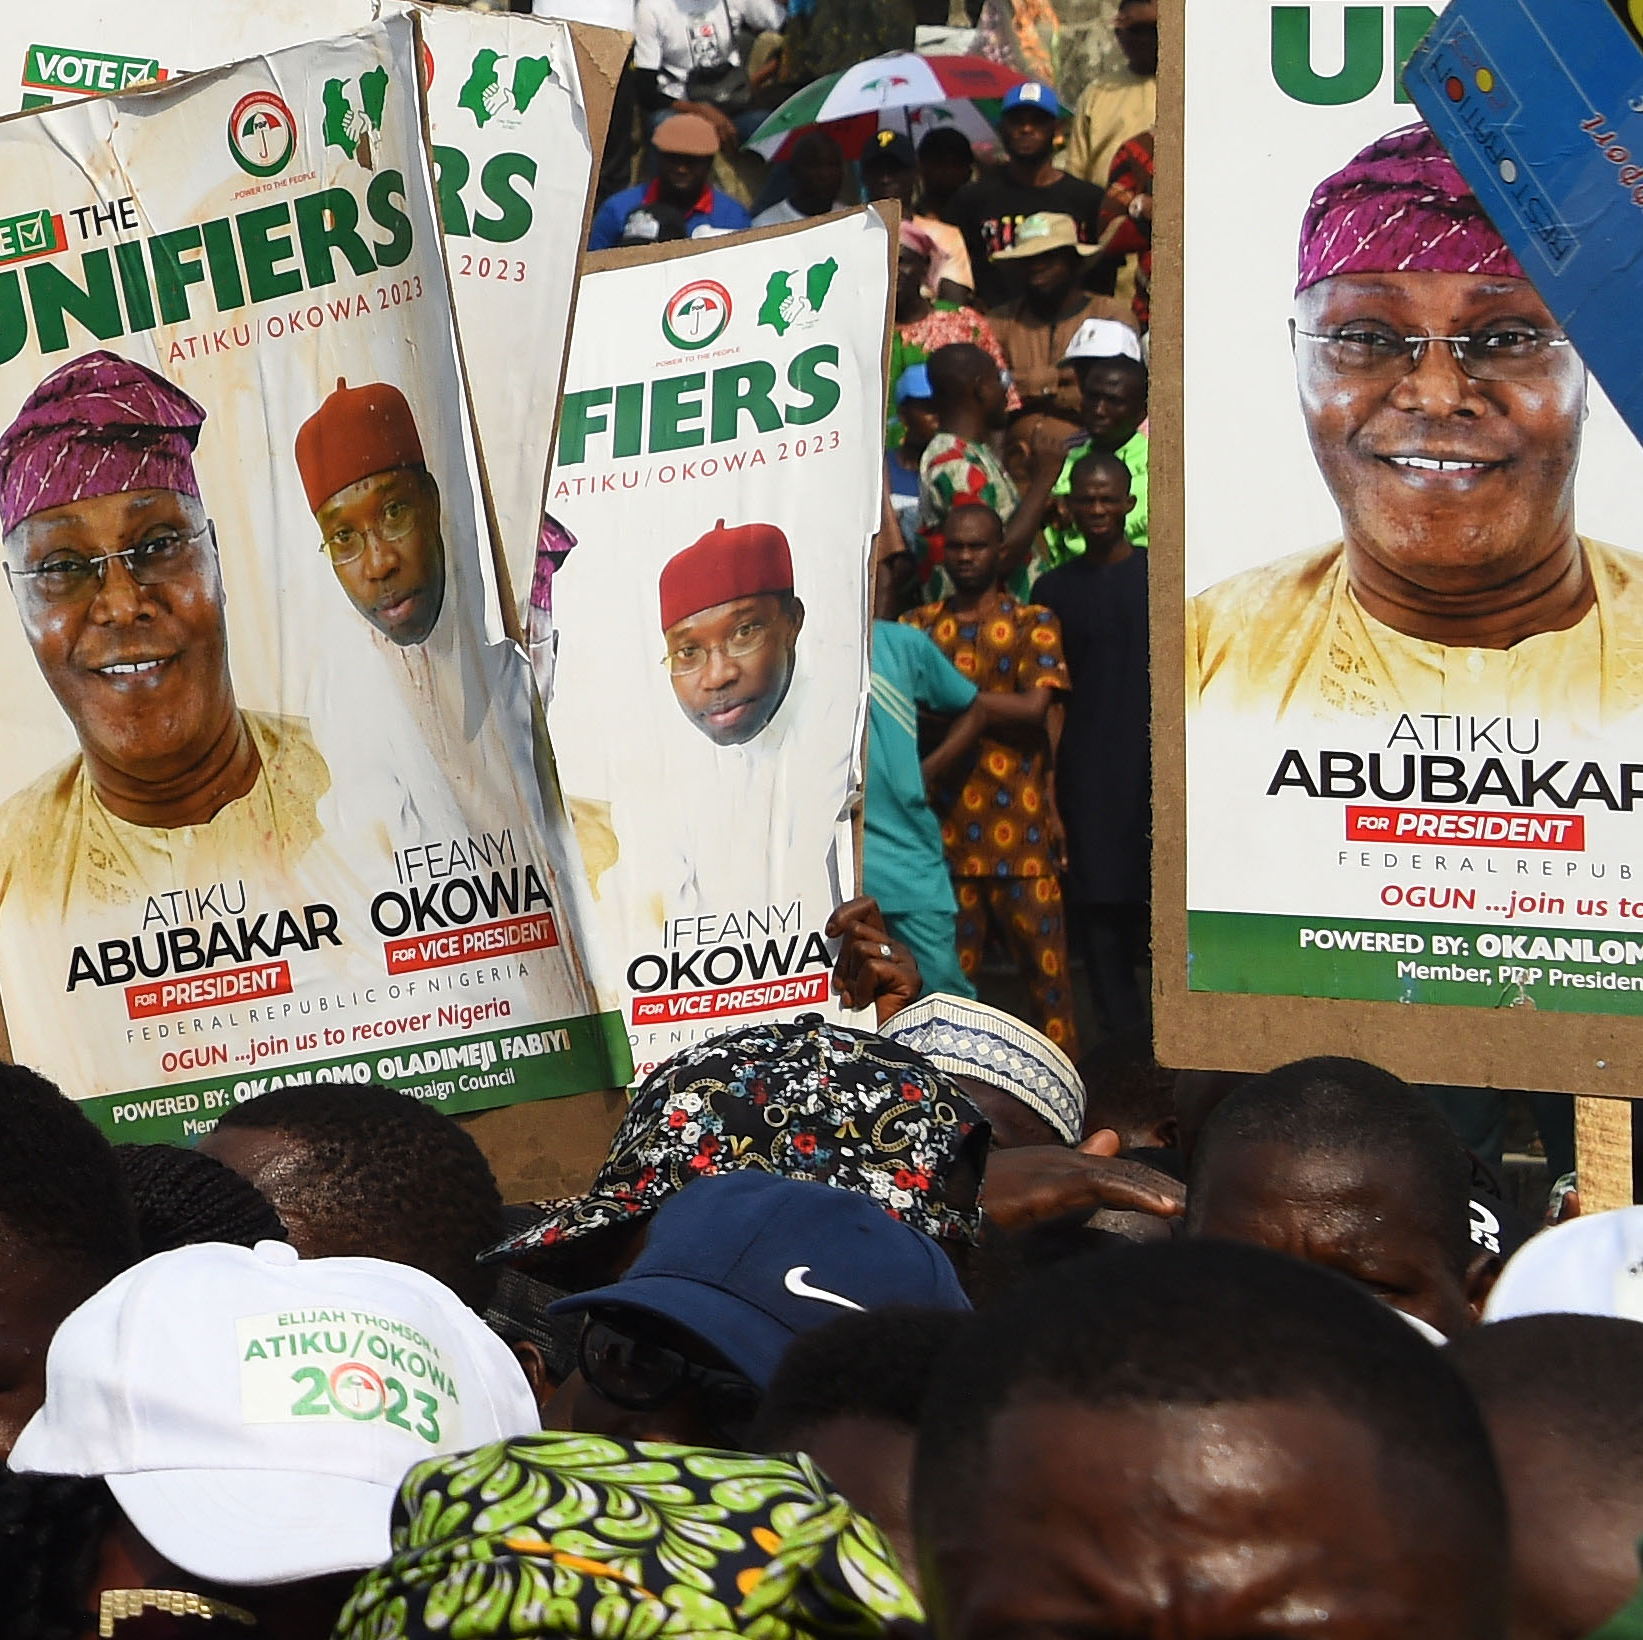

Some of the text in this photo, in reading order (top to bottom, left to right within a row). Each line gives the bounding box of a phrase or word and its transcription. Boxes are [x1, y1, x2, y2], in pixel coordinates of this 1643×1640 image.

[34, 51, 119, 91] VOTE
[70, 196, 138, 239] THE
[170, 274, 424, 362] ATIKU/OKOWA 2023
[553, 338, 840, 471] FIERS
[555, 431, 839, 497] ATIKU/OKOWA 2023
[67, 862, 553, 998] ABUBAKAR OKOWA
[626, 931, 834, 994] OKOWA
[243, 1329, 460, 1405] ATIKU/OKOWA
[278, 1310, 433, 1353] ELIJAH THOMSON
[290, 1361, 441, 1444] 2023
